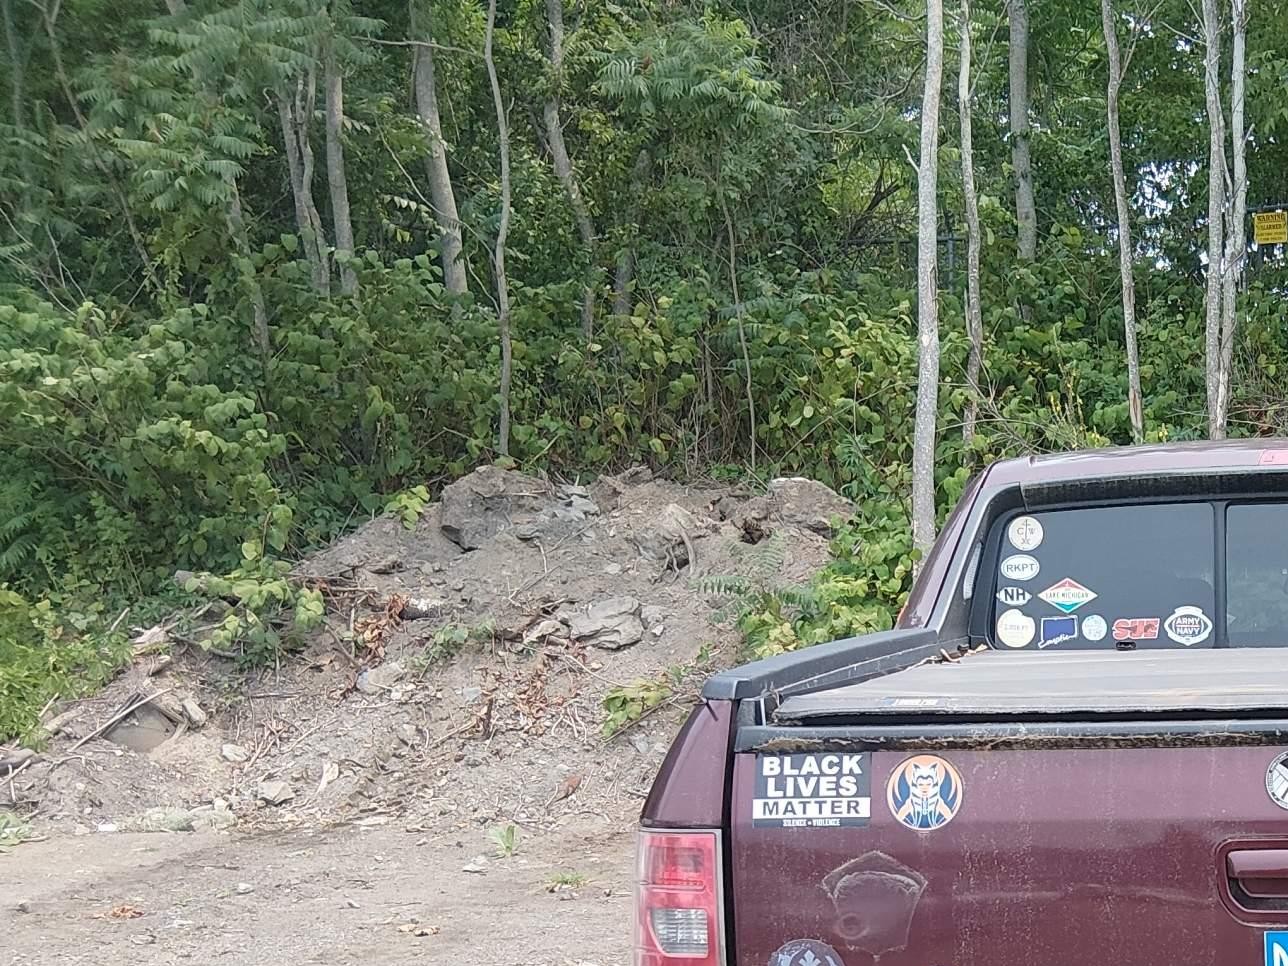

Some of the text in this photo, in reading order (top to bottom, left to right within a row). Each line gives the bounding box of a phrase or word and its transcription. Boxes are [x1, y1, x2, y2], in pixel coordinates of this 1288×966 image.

[1006, 563, 1034, 573] RKPT
[1004, 588, 1026, 601] NH
[1176, 617, 1200, 625] ARMY
[1176, 627, 1200, 635] NAVY
[762, 755, 863, 776] BLACK
[767, 776, 858, 797] LIVES
[762, 800, 860, 816] MATTER
